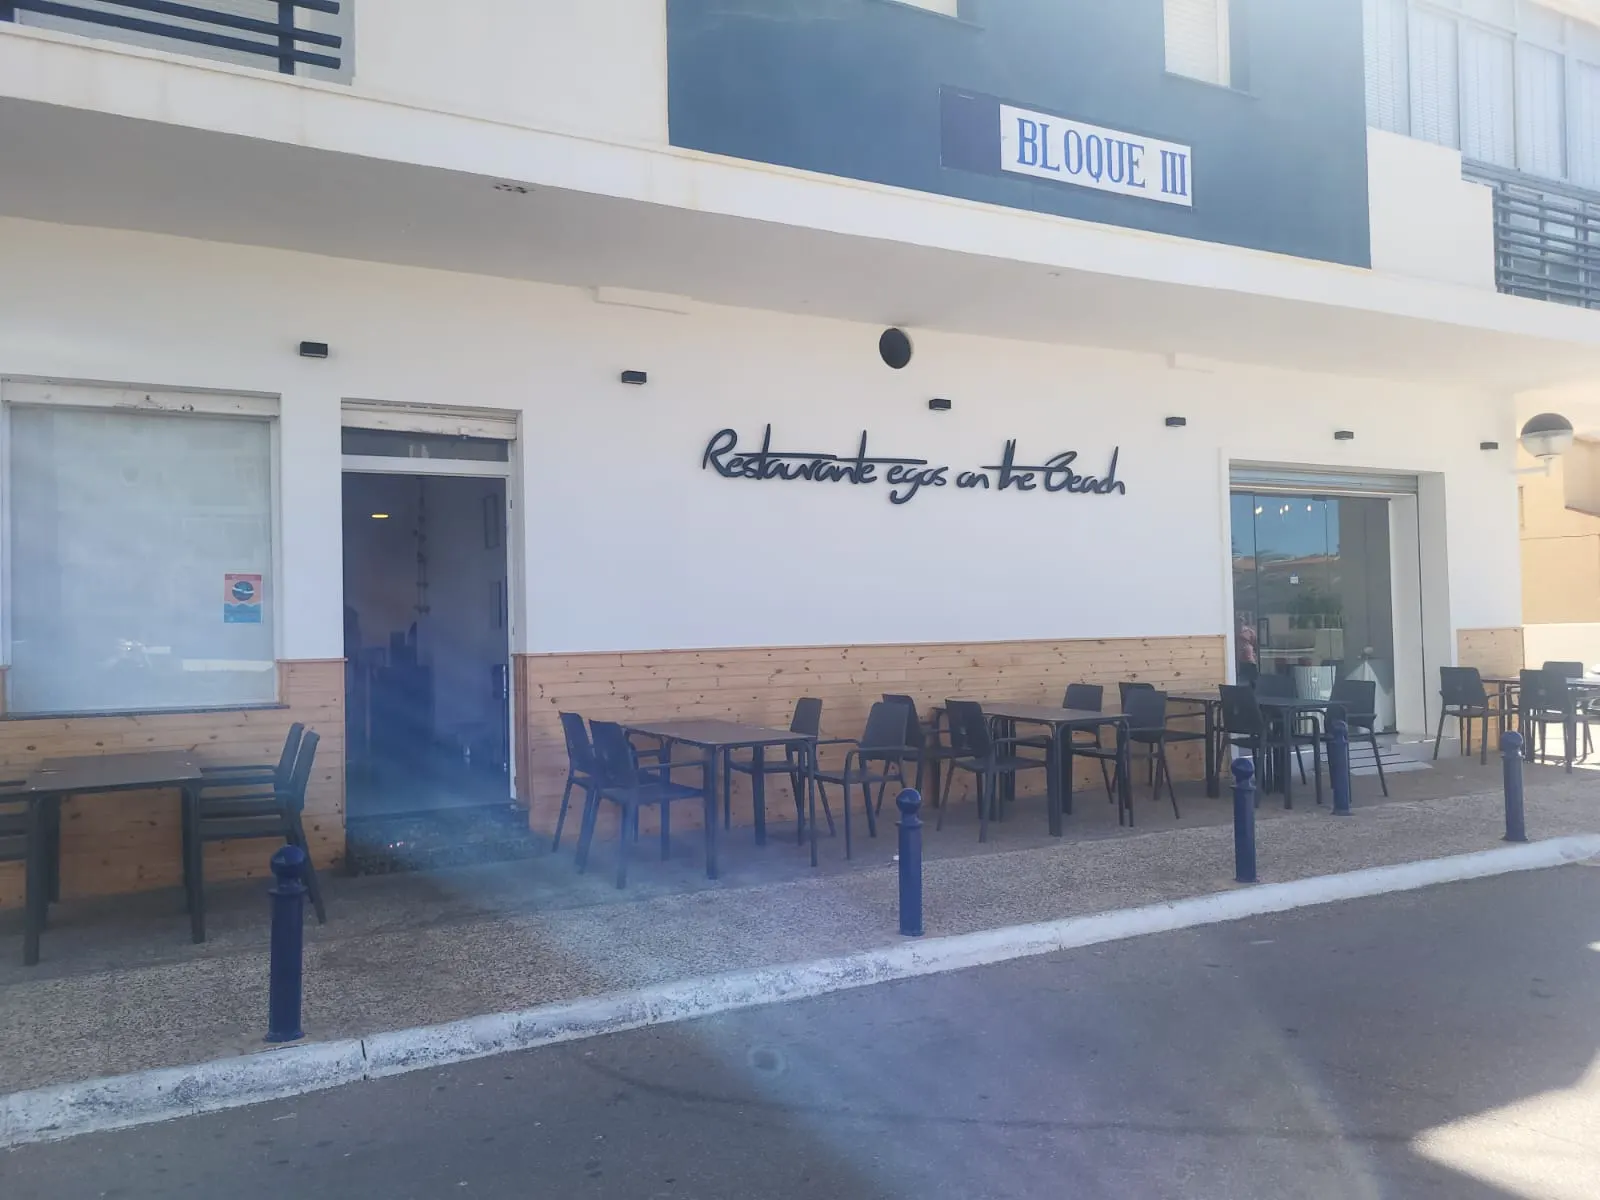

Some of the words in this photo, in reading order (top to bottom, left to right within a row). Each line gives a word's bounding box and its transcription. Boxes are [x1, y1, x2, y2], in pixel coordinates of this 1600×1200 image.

[1016, 117, 1146, 189] BLOQUE
[1160, 149, 1188, 197] III
[702, 423, 878, 485] Restaurante
[980, 438, 1037, 491] the
[1044, 445, 1126, 496] Beach
